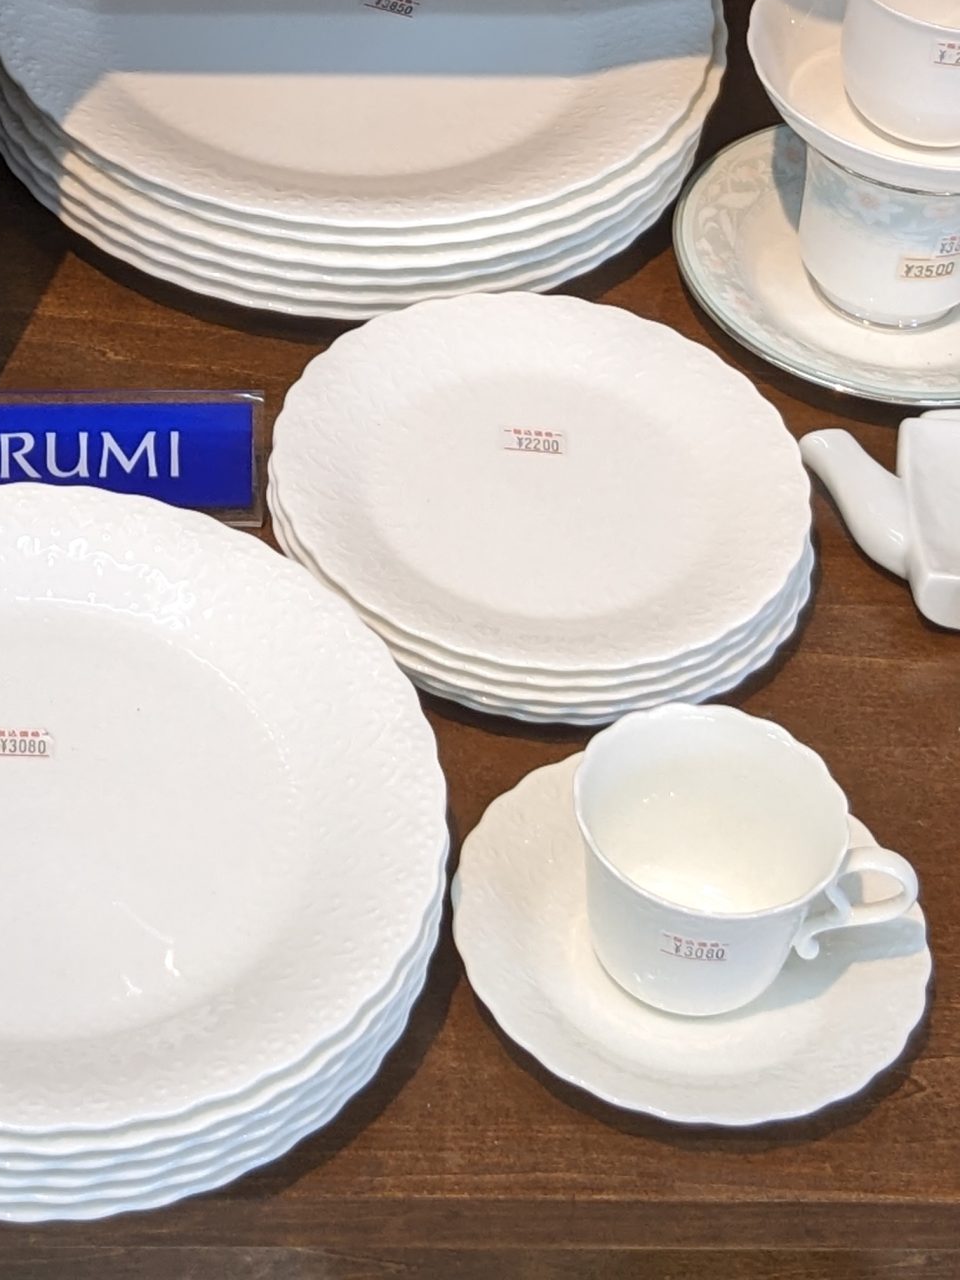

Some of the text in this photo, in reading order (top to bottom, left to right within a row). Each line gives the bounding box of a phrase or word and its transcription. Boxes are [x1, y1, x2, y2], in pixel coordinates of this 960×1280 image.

[904, 262, 954, 278] ¥3500
[516, 436, 559, 453] ¥2200
[0, 738, 46, 754] ¥3080
